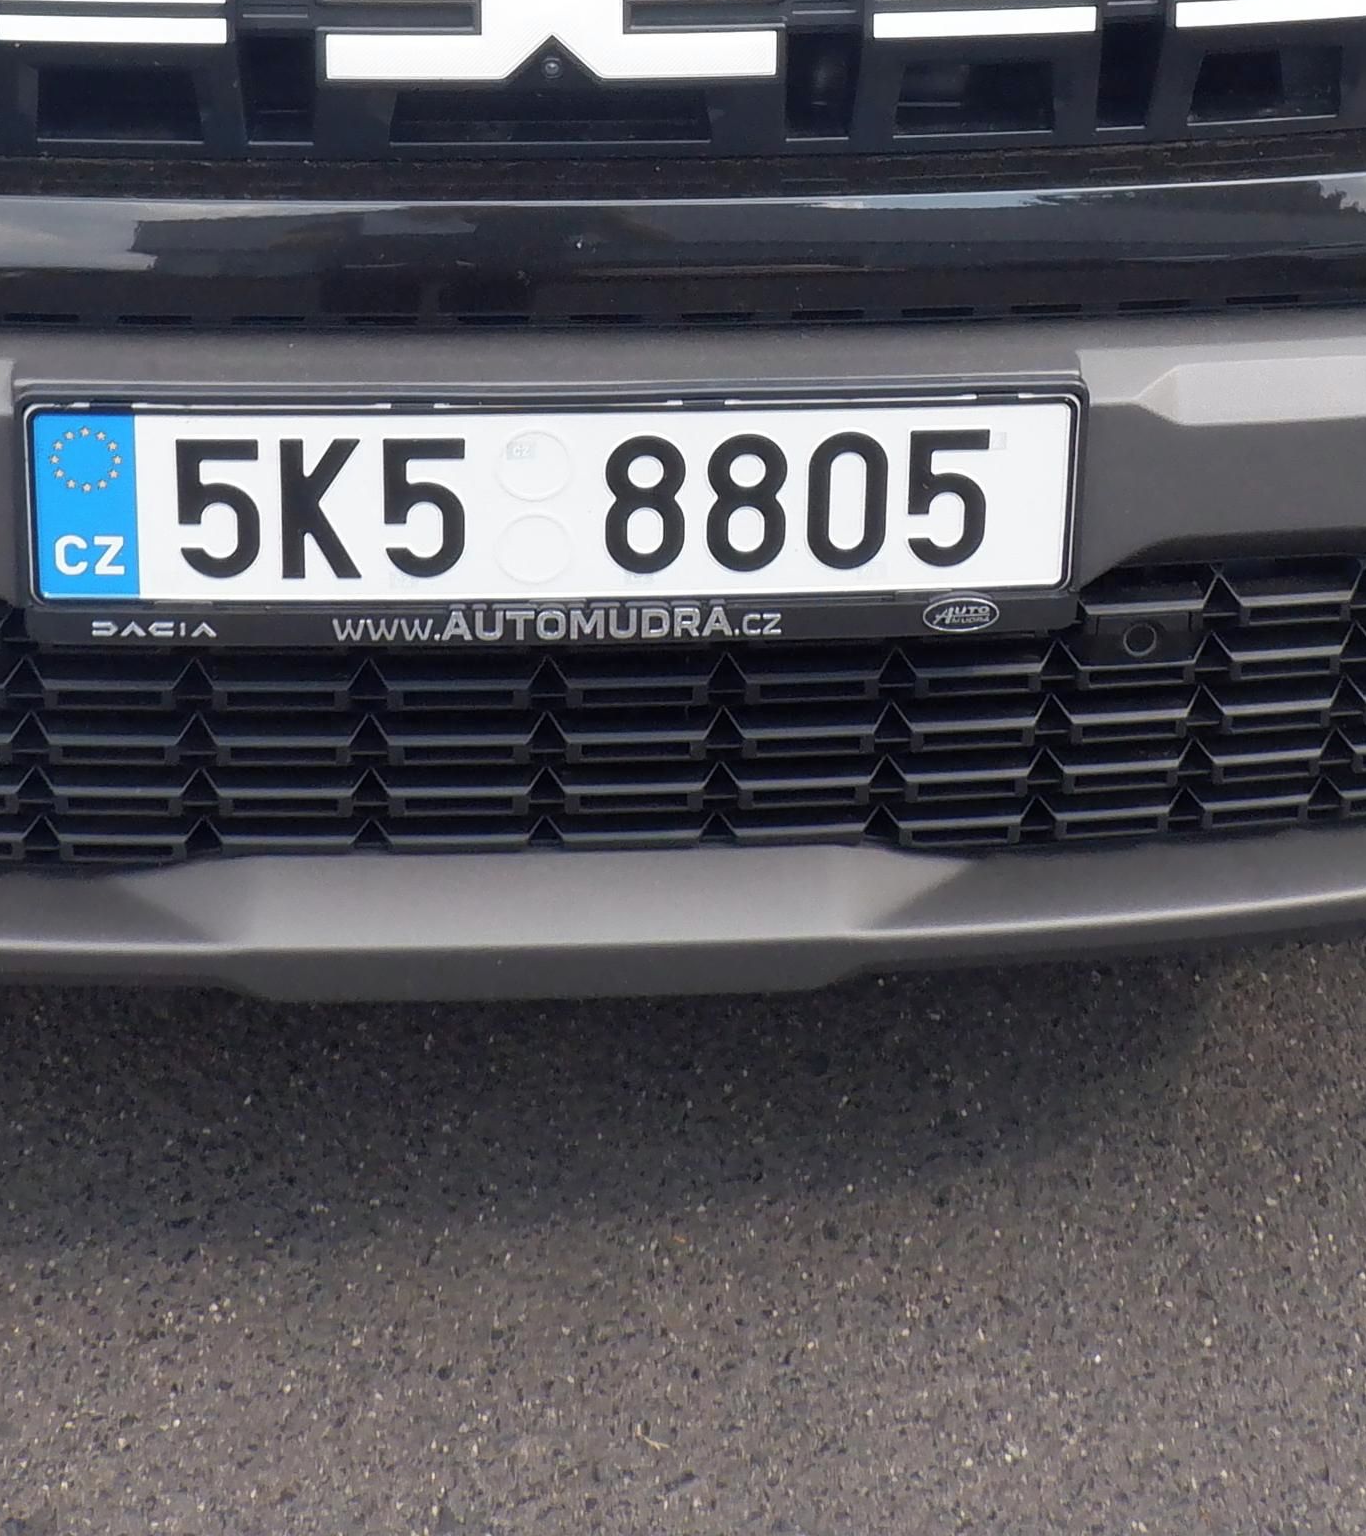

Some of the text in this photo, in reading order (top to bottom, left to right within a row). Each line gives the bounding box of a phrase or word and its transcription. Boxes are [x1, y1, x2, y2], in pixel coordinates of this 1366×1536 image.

[175, 429, 991, 579] 5K5 8805
[53, 534, 126, 576] CZ
[91, 619, 218, 639] DACIA
[933, 606, 990, 625] AUTO
